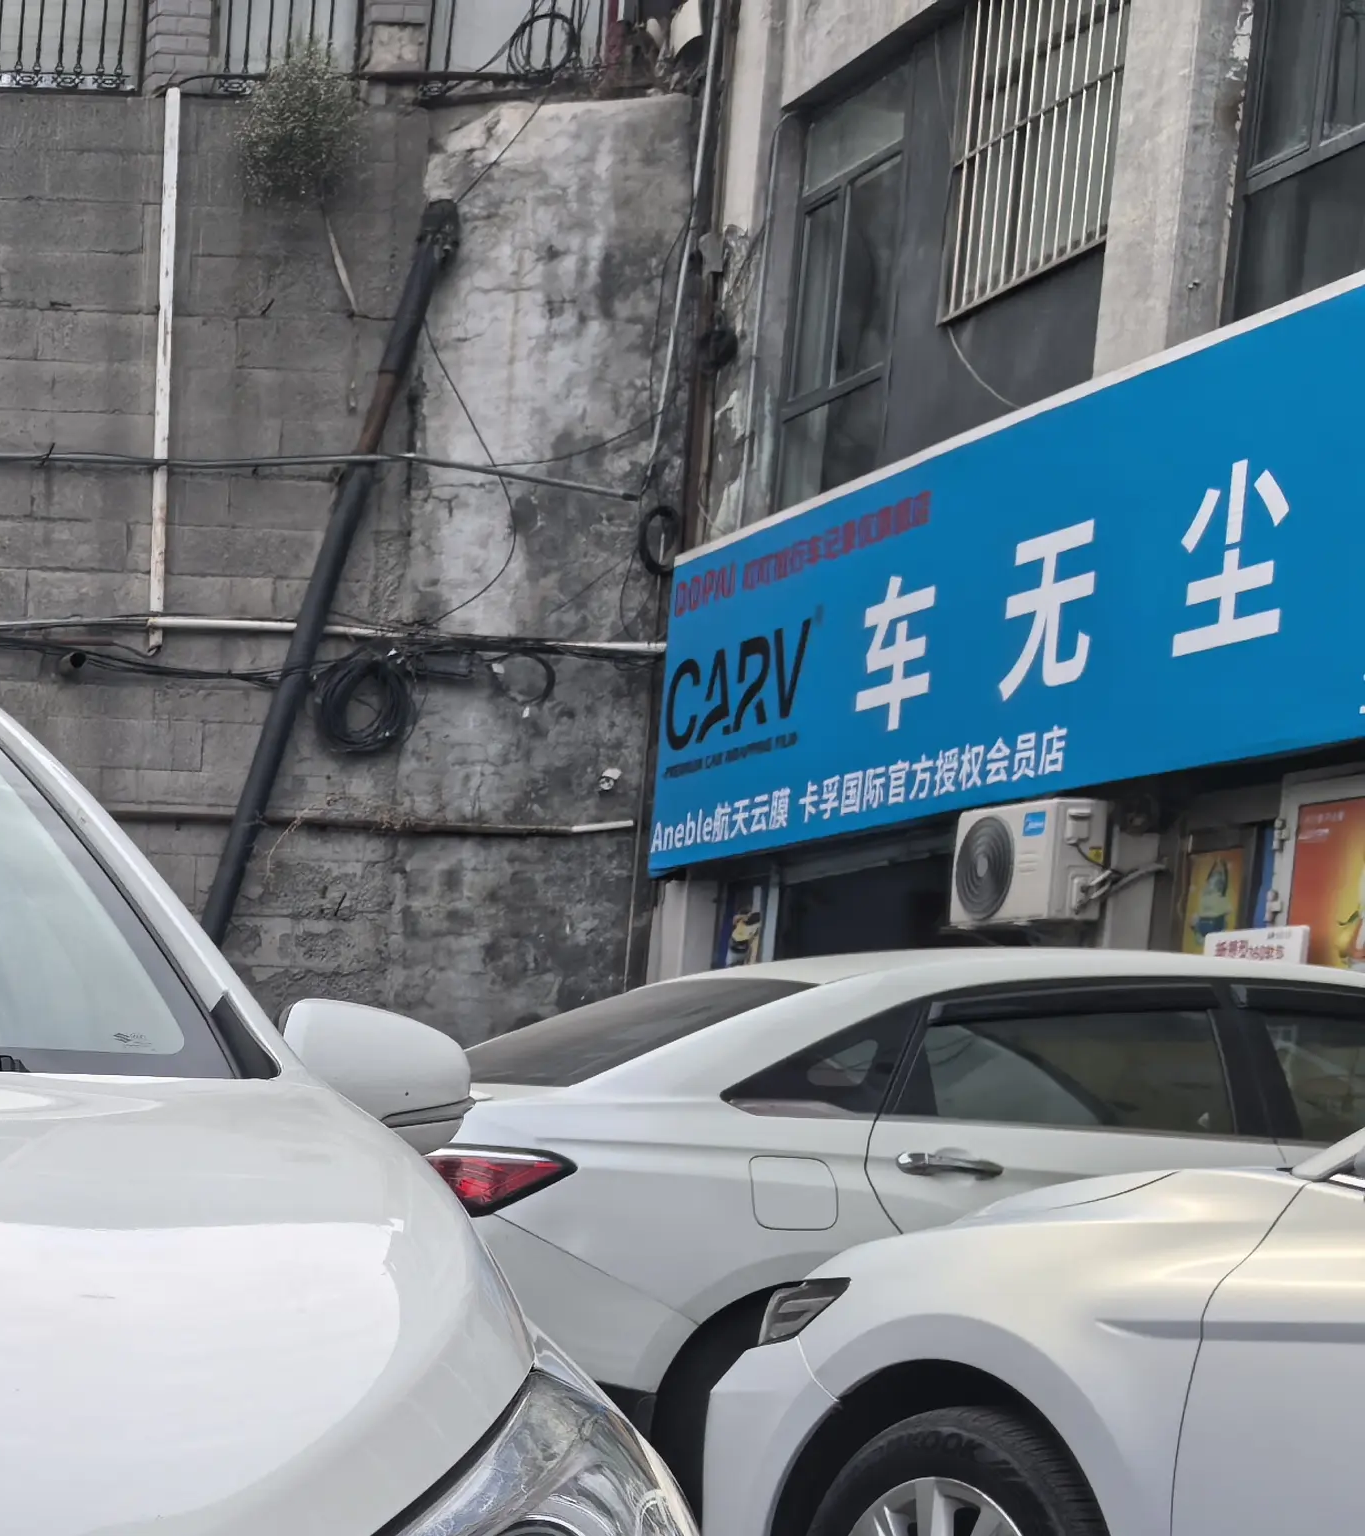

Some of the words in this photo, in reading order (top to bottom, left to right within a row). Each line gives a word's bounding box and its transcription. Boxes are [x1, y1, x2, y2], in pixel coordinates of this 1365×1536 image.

[855, 458, 1290, 732] 车无尘
[665, 617, 813, 751] CARV
[799, 724, 1068, 824] 卡孚国际官方授权会员店
